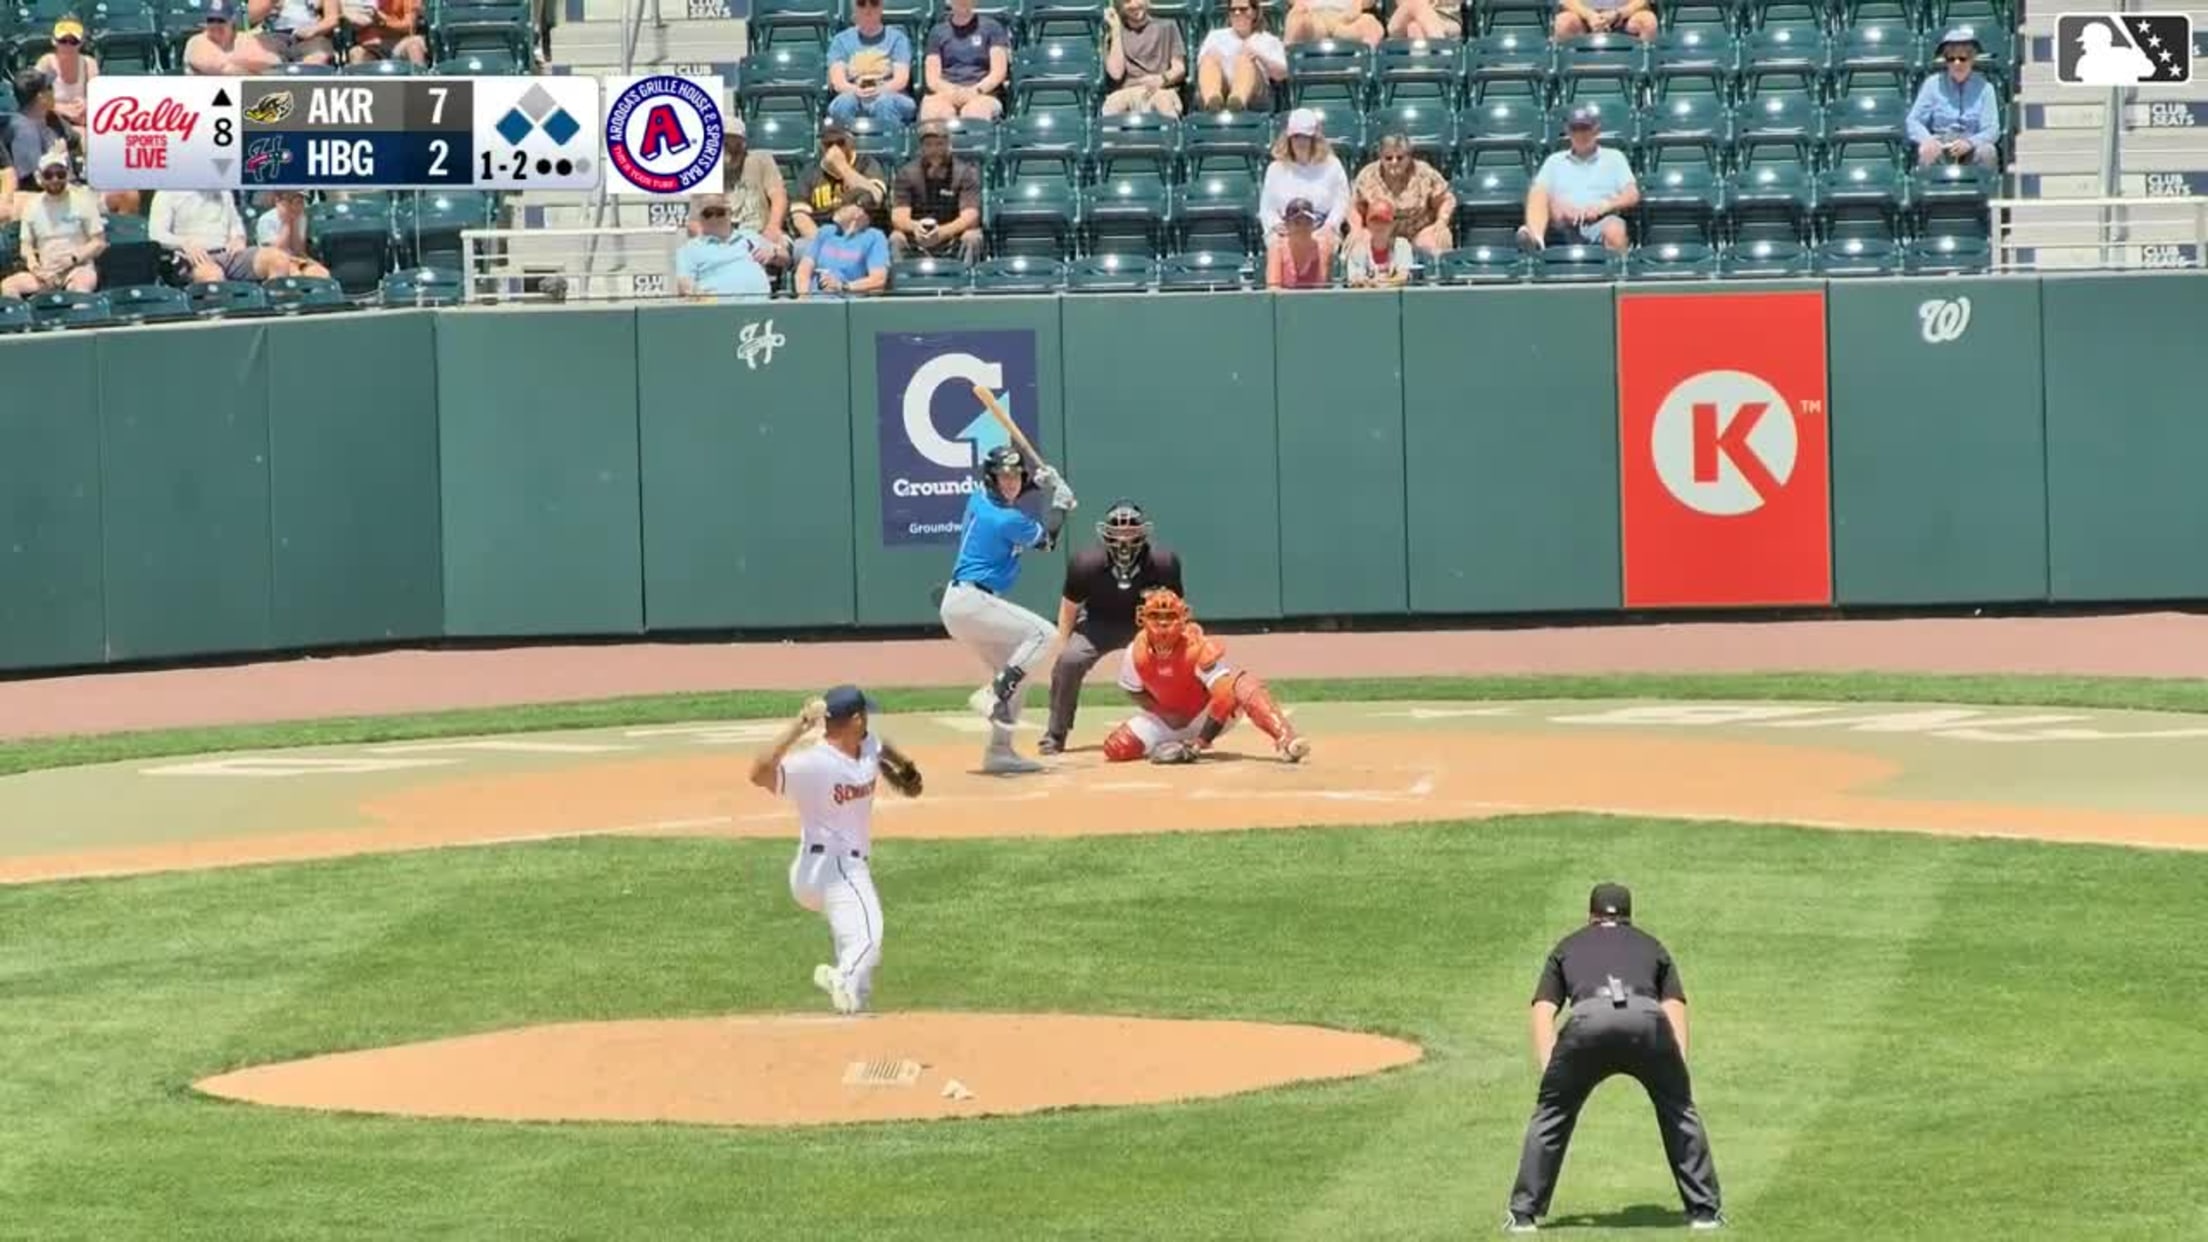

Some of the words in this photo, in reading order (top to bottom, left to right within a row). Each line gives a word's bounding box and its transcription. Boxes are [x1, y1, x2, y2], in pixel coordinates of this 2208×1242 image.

[2152, 103, 2188, 114] CLUB
[2148, 173, 2184, 185] CLUB
[651, 204, 687, 214] CLUB
[1801, 399, 1822, 414] TM
[1692, 402, 1784, 502] K
